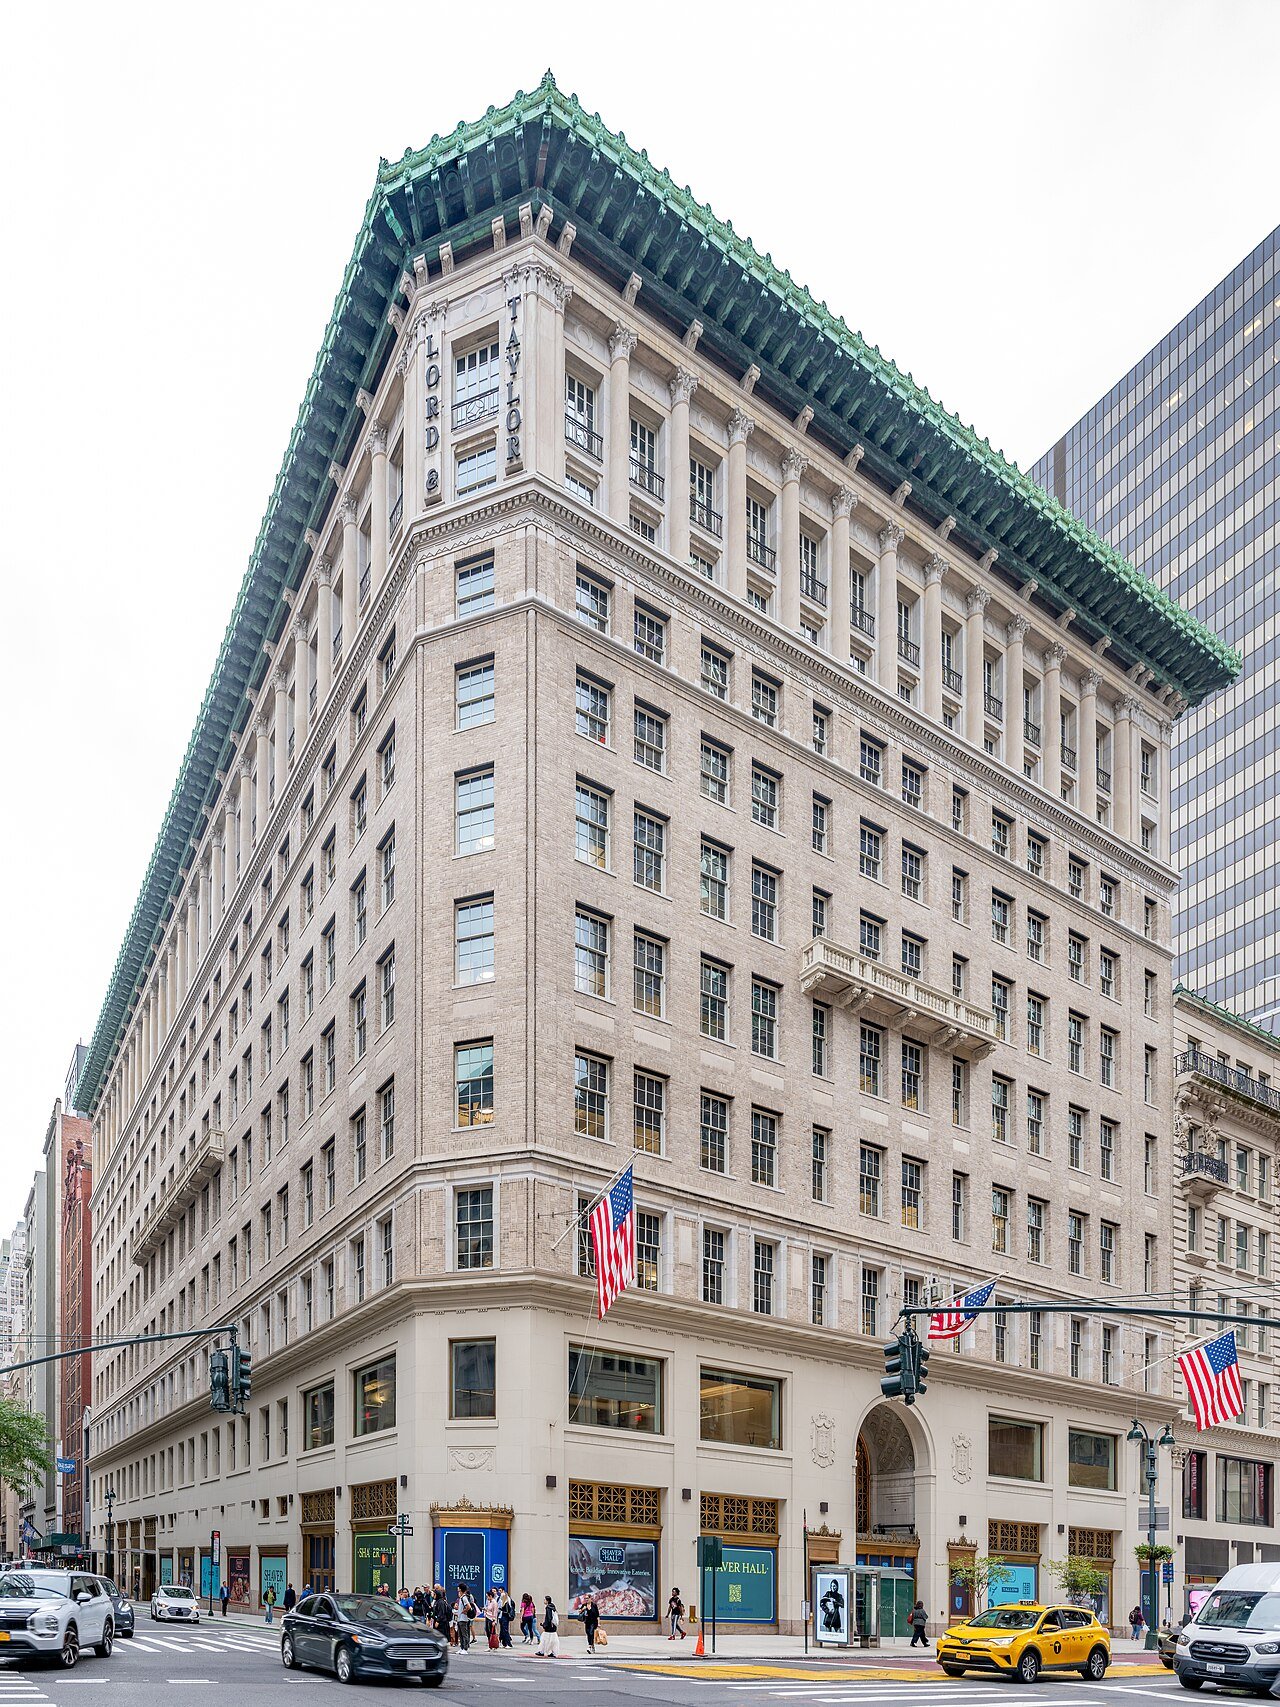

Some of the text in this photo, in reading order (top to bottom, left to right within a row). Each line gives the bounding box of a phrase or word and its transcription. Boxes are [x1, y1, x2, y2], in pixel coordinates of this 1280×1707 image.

[505, 294, 522, 461] TAYLOR
[426, 334, 441, 491] LORD &
[358, 1547, 380, 1558] SHAER
[602, 1549, 622, 1557] SHAVER
[448, 1564, 480, 1573] SHAVER
[742, 1562, 767, 1574] HALL
[263, 1569, 284, 1582] SHAVER
[453, 1572, 475, 1580] HALL
